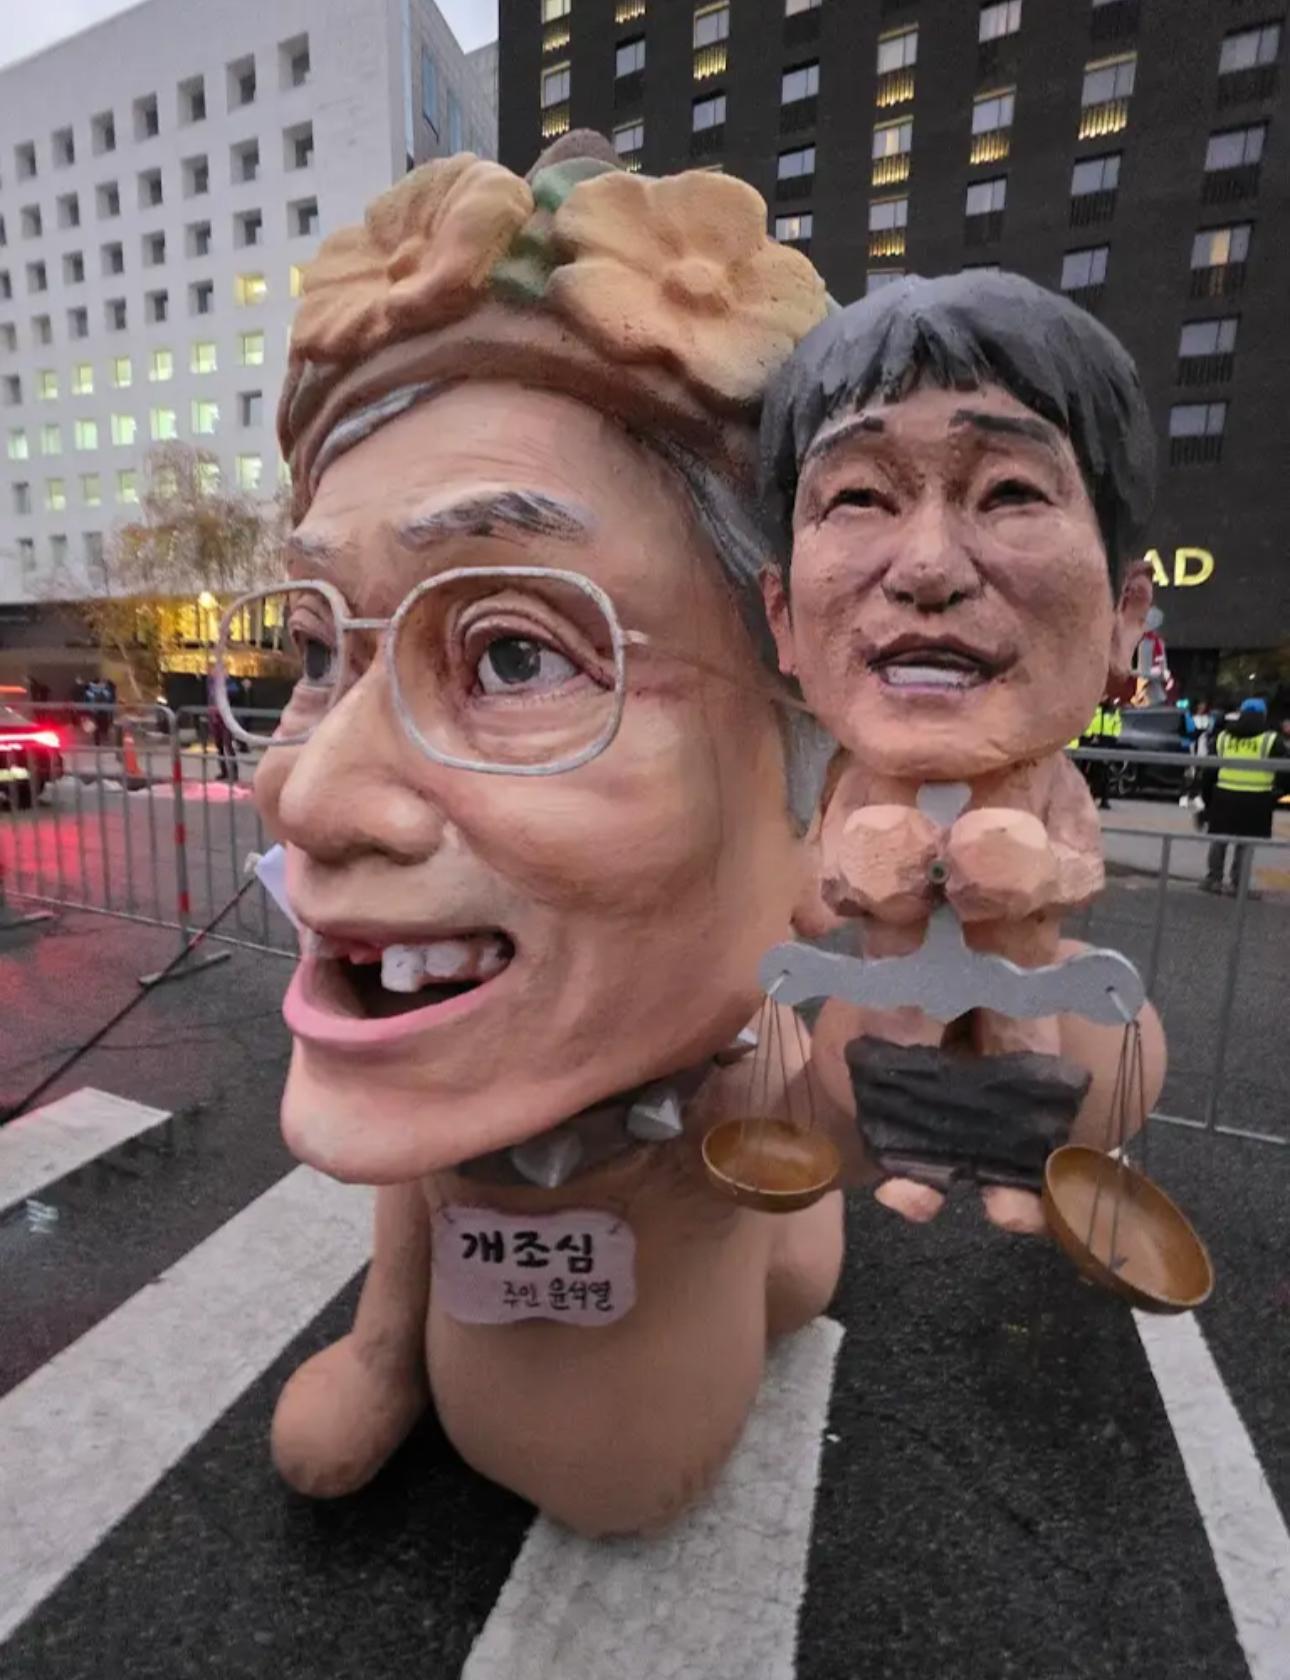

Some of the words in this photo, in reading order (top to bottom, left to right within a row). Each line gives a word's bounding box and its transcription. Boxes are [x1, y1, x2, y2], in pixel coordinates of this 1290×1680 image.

[460, 1230, 594, 1274] 개조심
[503, 1281, 540, 1309] 주인
[548, 1277, 613, 1311] 윤석열
